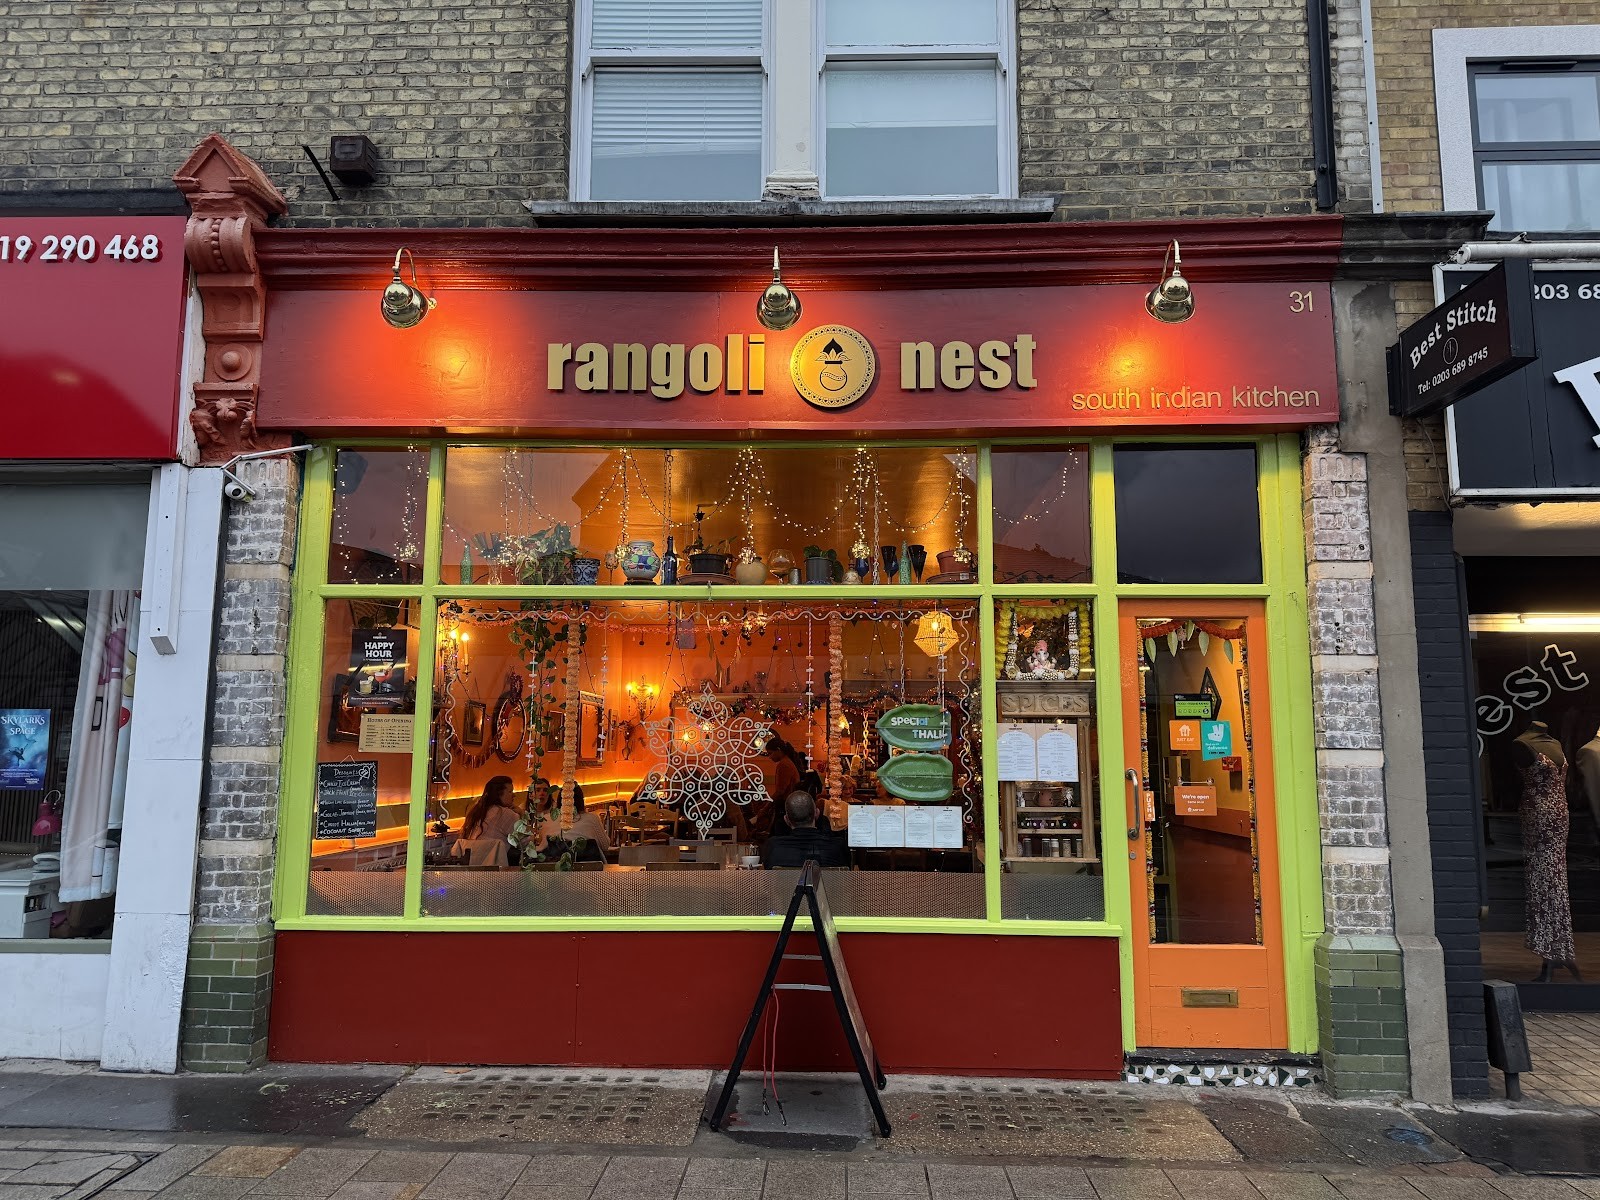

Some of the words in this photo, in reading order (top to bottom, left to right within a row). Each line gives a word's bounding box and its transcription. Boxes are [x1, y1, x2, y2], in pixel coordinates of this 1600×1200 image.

[40, 235, 95, 260] 290
[104, 235, 159, 260] 468
[1289, 291, 1313, 312] 31
[1410, 322, 1442, 369] Best
[1446, 299, 1497, 332] Stitch
[547, 333, 766, 399] rangoli
[901, 334, 1037, 389] nest
[1418, 380, 1431, 394] Tel:
[1433, 368, 1450, 387] 0203
[1452, 359, 1466, 376] 689
[1468, 346, 1488, 367] 8745
[1071, 387, 1140, 410] south
[1150, 386, 1221, 409] indian
[1232, 386, 1320, 408] kitchen
[364, 641, 395, 650] HAPPY
[365, 650, 393, 658] HOUR
[1002, 694, 1090, 712] SPICES
[1475, 644, 1589, 742] est
[1, 715, 46, 726] SKYLARKS
[10, 727, 36, 735] SPACE
